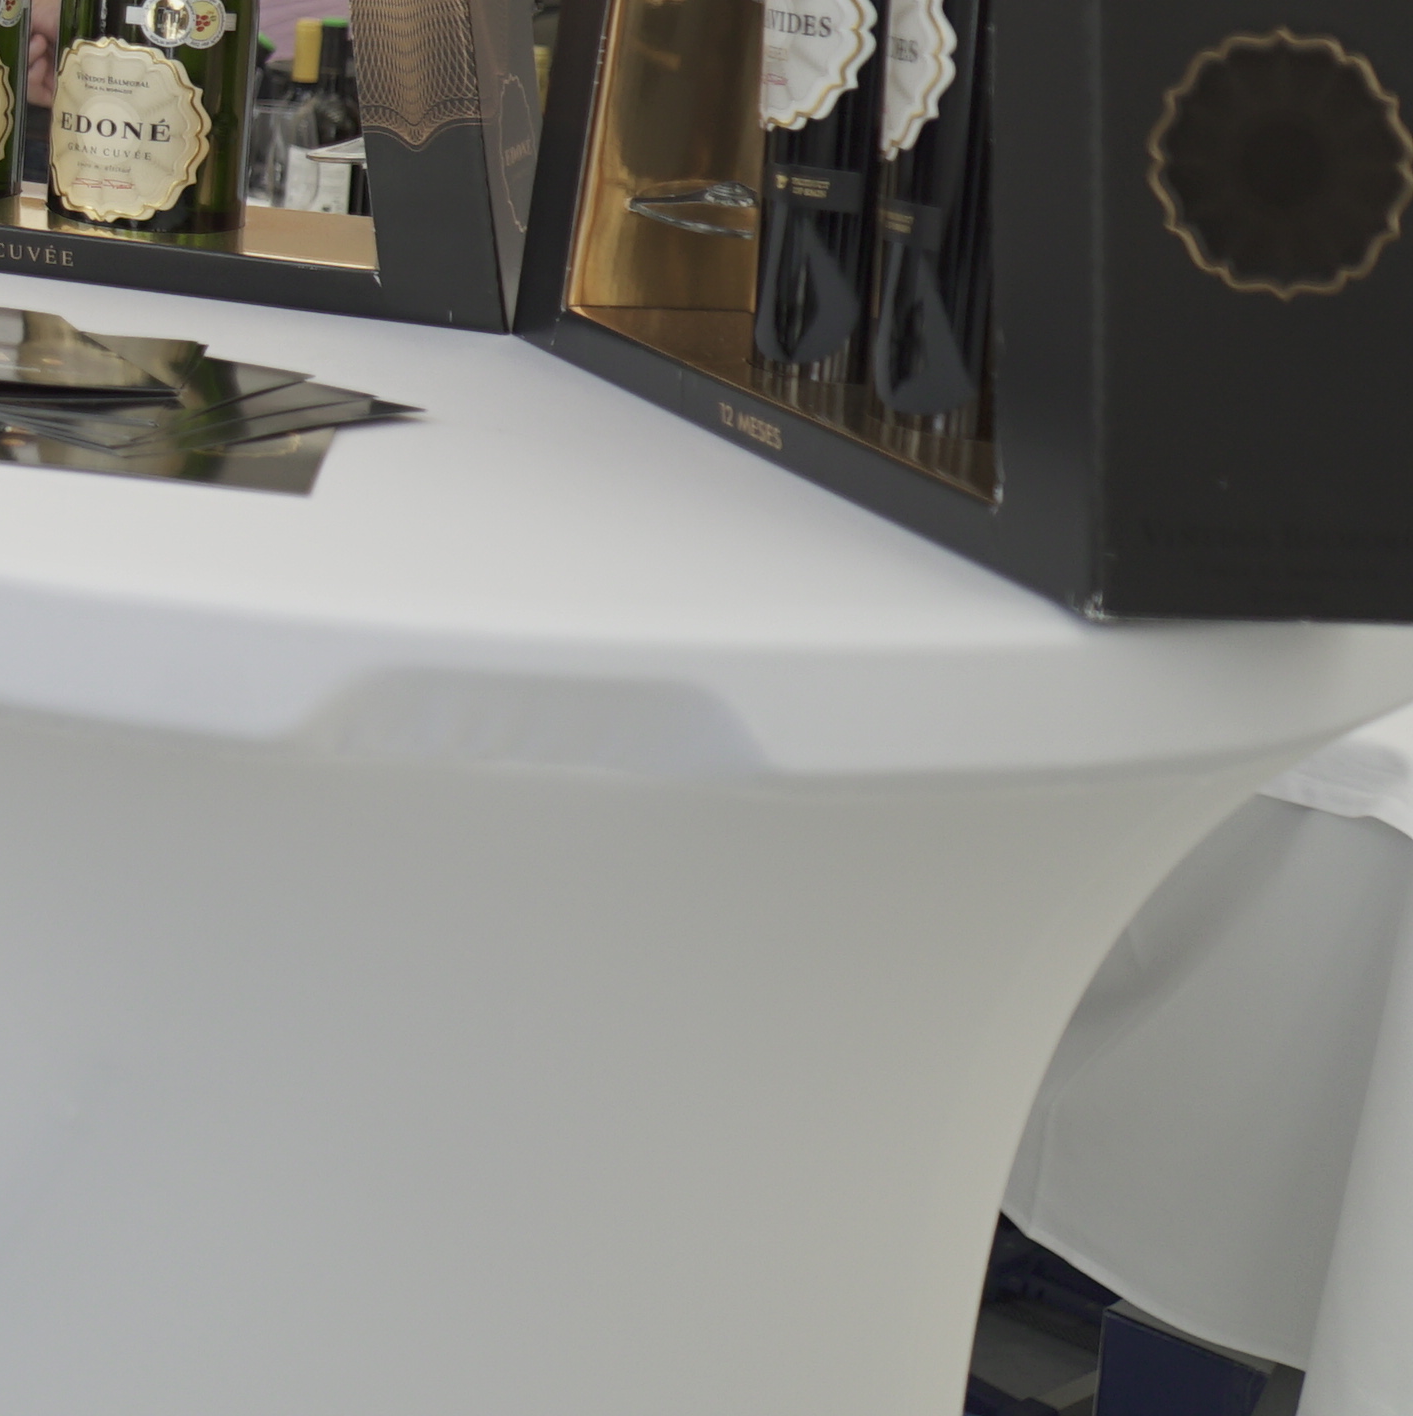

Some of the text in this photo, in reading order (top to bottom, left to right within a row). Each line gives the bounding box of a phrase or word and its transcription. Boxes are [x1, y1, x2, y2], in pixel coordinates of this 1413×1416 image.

[764, 8, 832, 38] VIDES
[61, 111, 172, 143] EDONÉ
[67, 142, 153, 162] GRAN CUVÉE
